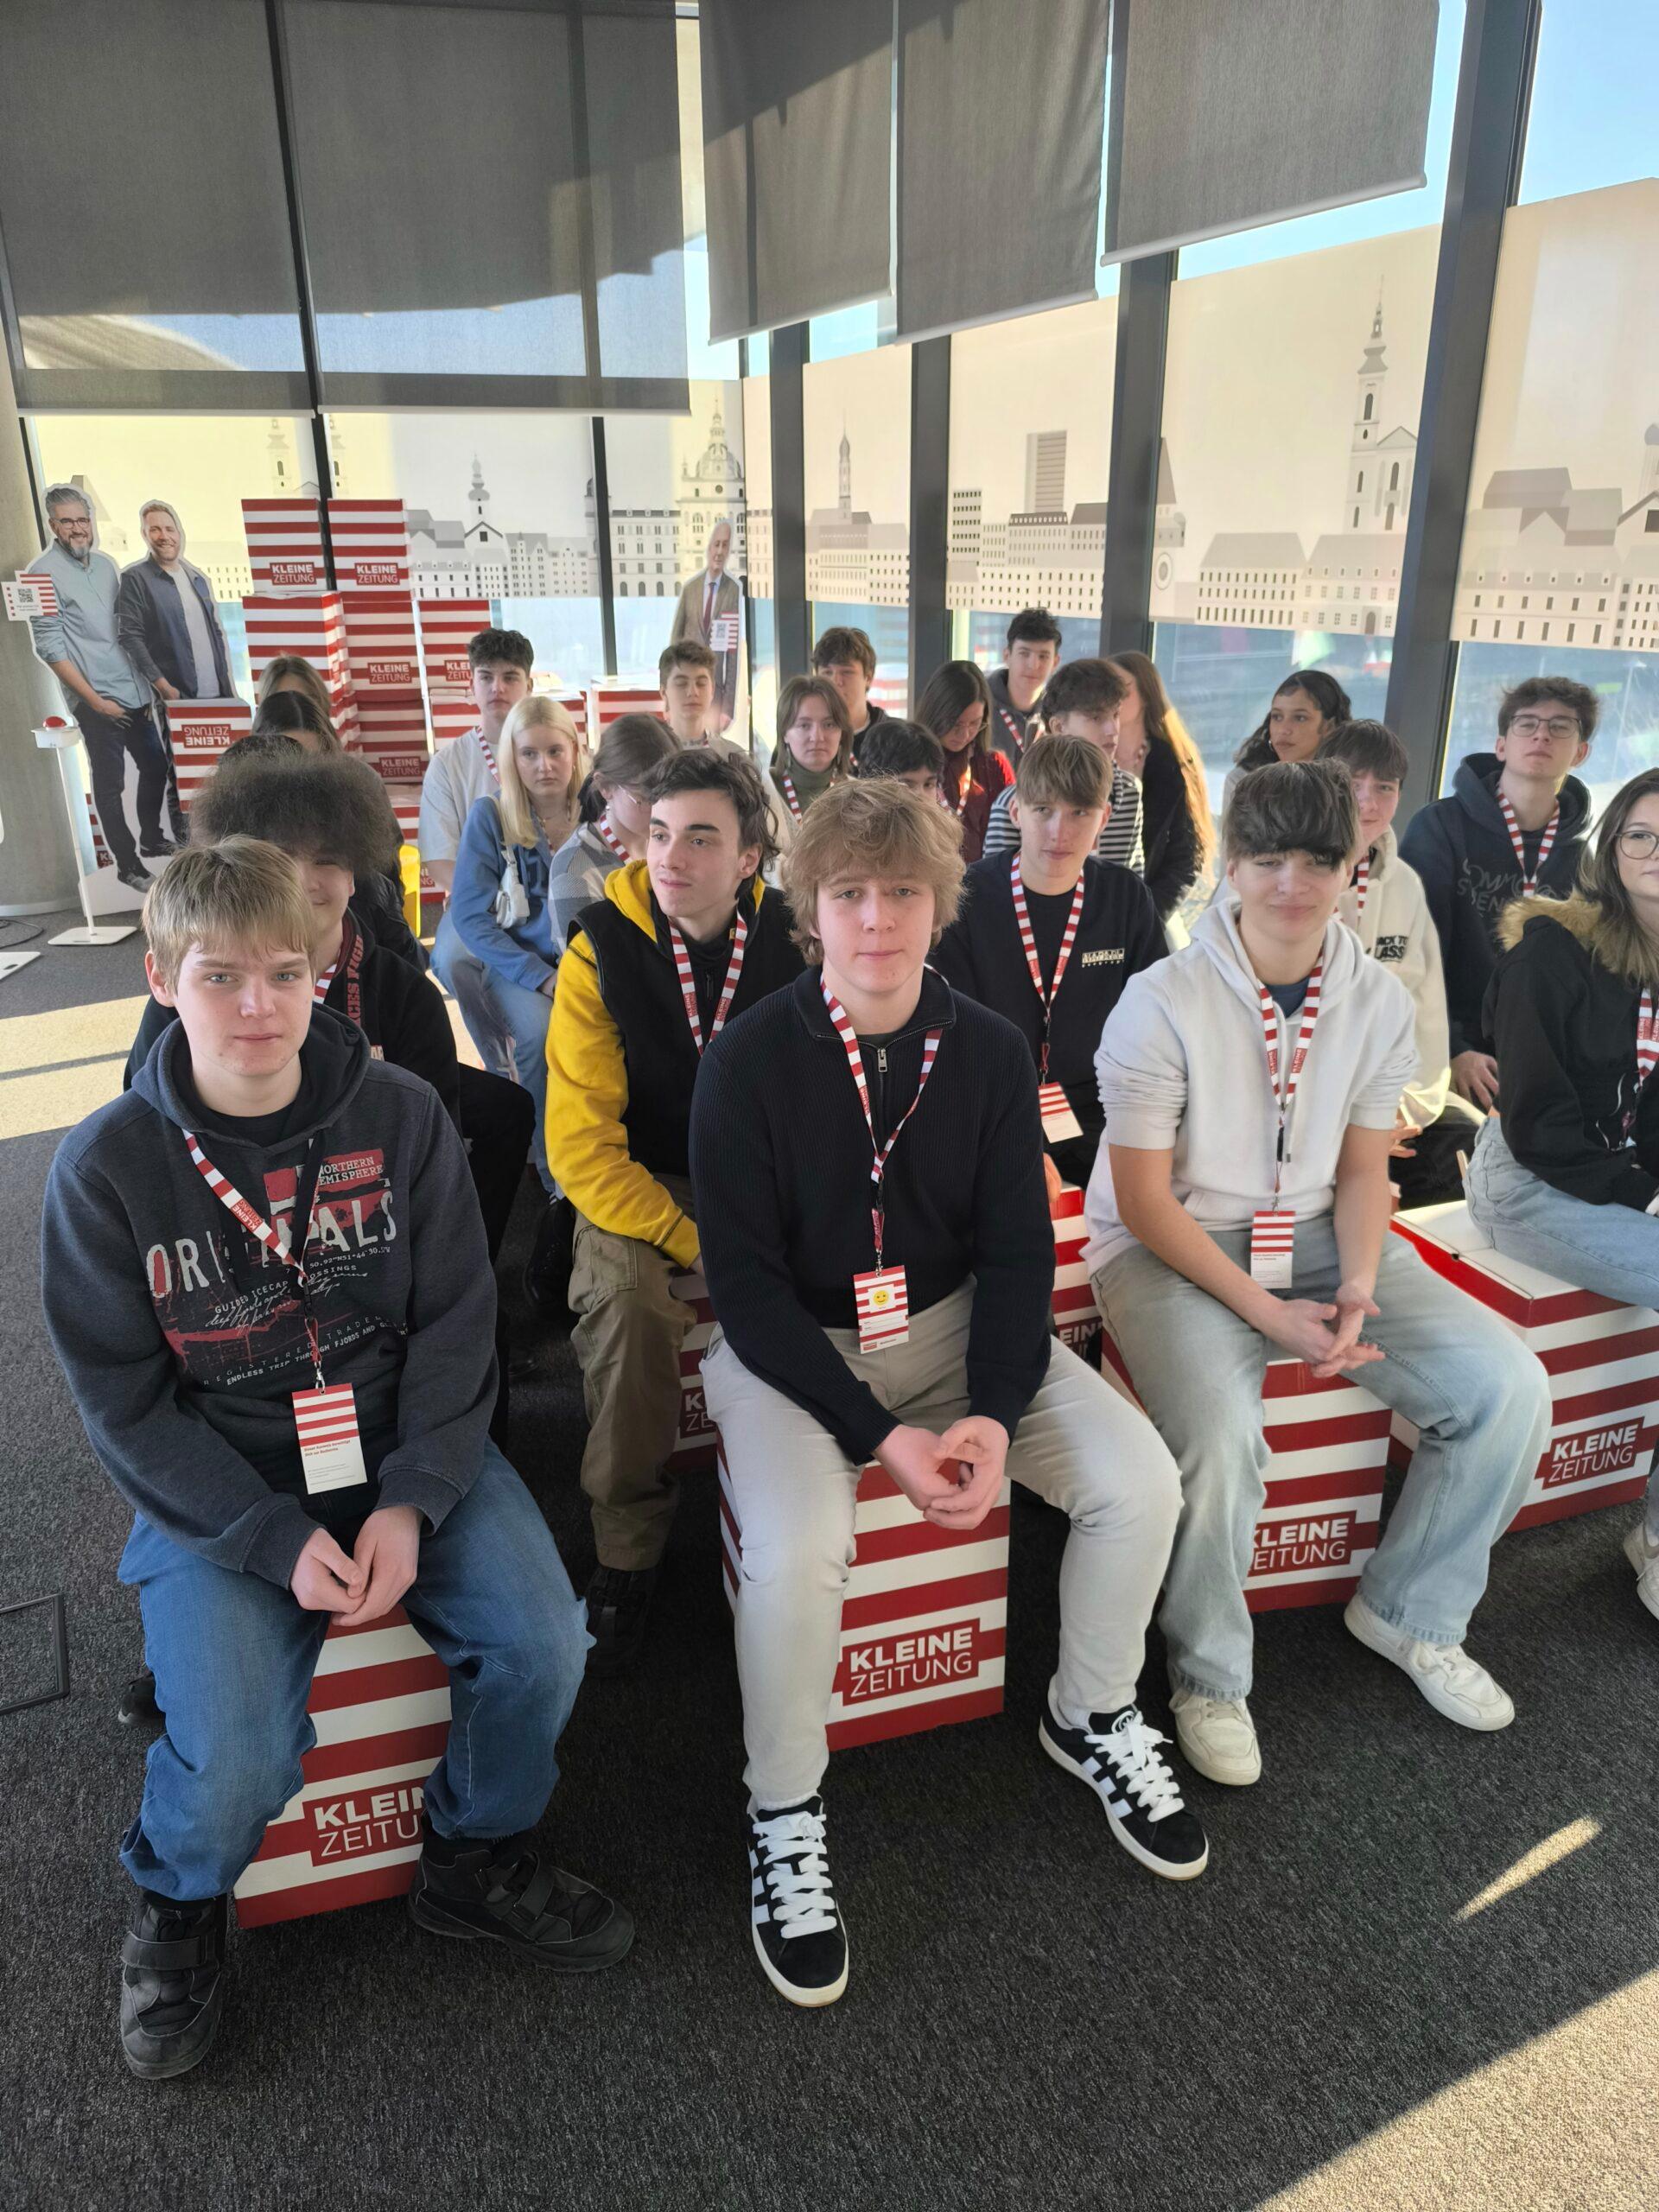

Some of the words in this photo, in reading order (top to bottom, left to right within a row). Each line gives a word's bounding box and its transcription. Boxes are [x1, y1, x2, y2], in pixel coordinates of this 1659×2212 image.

[271, 563, 314, 574] KLEINE
[273, 574, 315, 584] ZEITUNG
[356, 564, 397, 574] KLEINE
[358, 574, 398, 584] ZEITUNG
[369, 664, 410, 673] KLEINE
[446, 661, 471, 671] KLEI
[447, 671, 473, 680] ZEITU
[371, 672, 410, 683] ZEITUNG
[184, 725, 230, 735] ZEITUNG
[186, 736, 231, 746] KLEINE
[381, 758, 419, 767] KLEINE
[383, 766, 421, 775] ZEITUNG
[318, 1165, 384, 1186] EMISPHERE
[232, 1205, 257, 1230] KLEINE
[146, 1191, 397, 1299] ORIALS
[214, 1294, 249, 1314] GUIDED
[251, 1281, 289, 1298] ICECAP
[309, 1265, 357, 1280] OSSINGS
[1059, 1322, 1103, 1344] EIN
[226, 1368, 264, 1386] ENDLESS
[269, 1360, 290, 1371] TRIP
[295, 1344, 330, 1363] THROGH
[334, 1332, 360, 1348] FJORDS
[363, 1325, 376, 1336] AND
[1553, 1423, 1639, 1462] KLEINE
[1548, 1445, 1633, 1483] ZEITUNG
[1252, 1541, 1346, 1571] EITUNG
[849, 1626, 973, 1674] KLEINE
[849, 1651, 972, 1698] ZEITUNG
[314, 1786, 424, 1830] KLEIN
[318, 1814, 419, 1857] ZEITU
